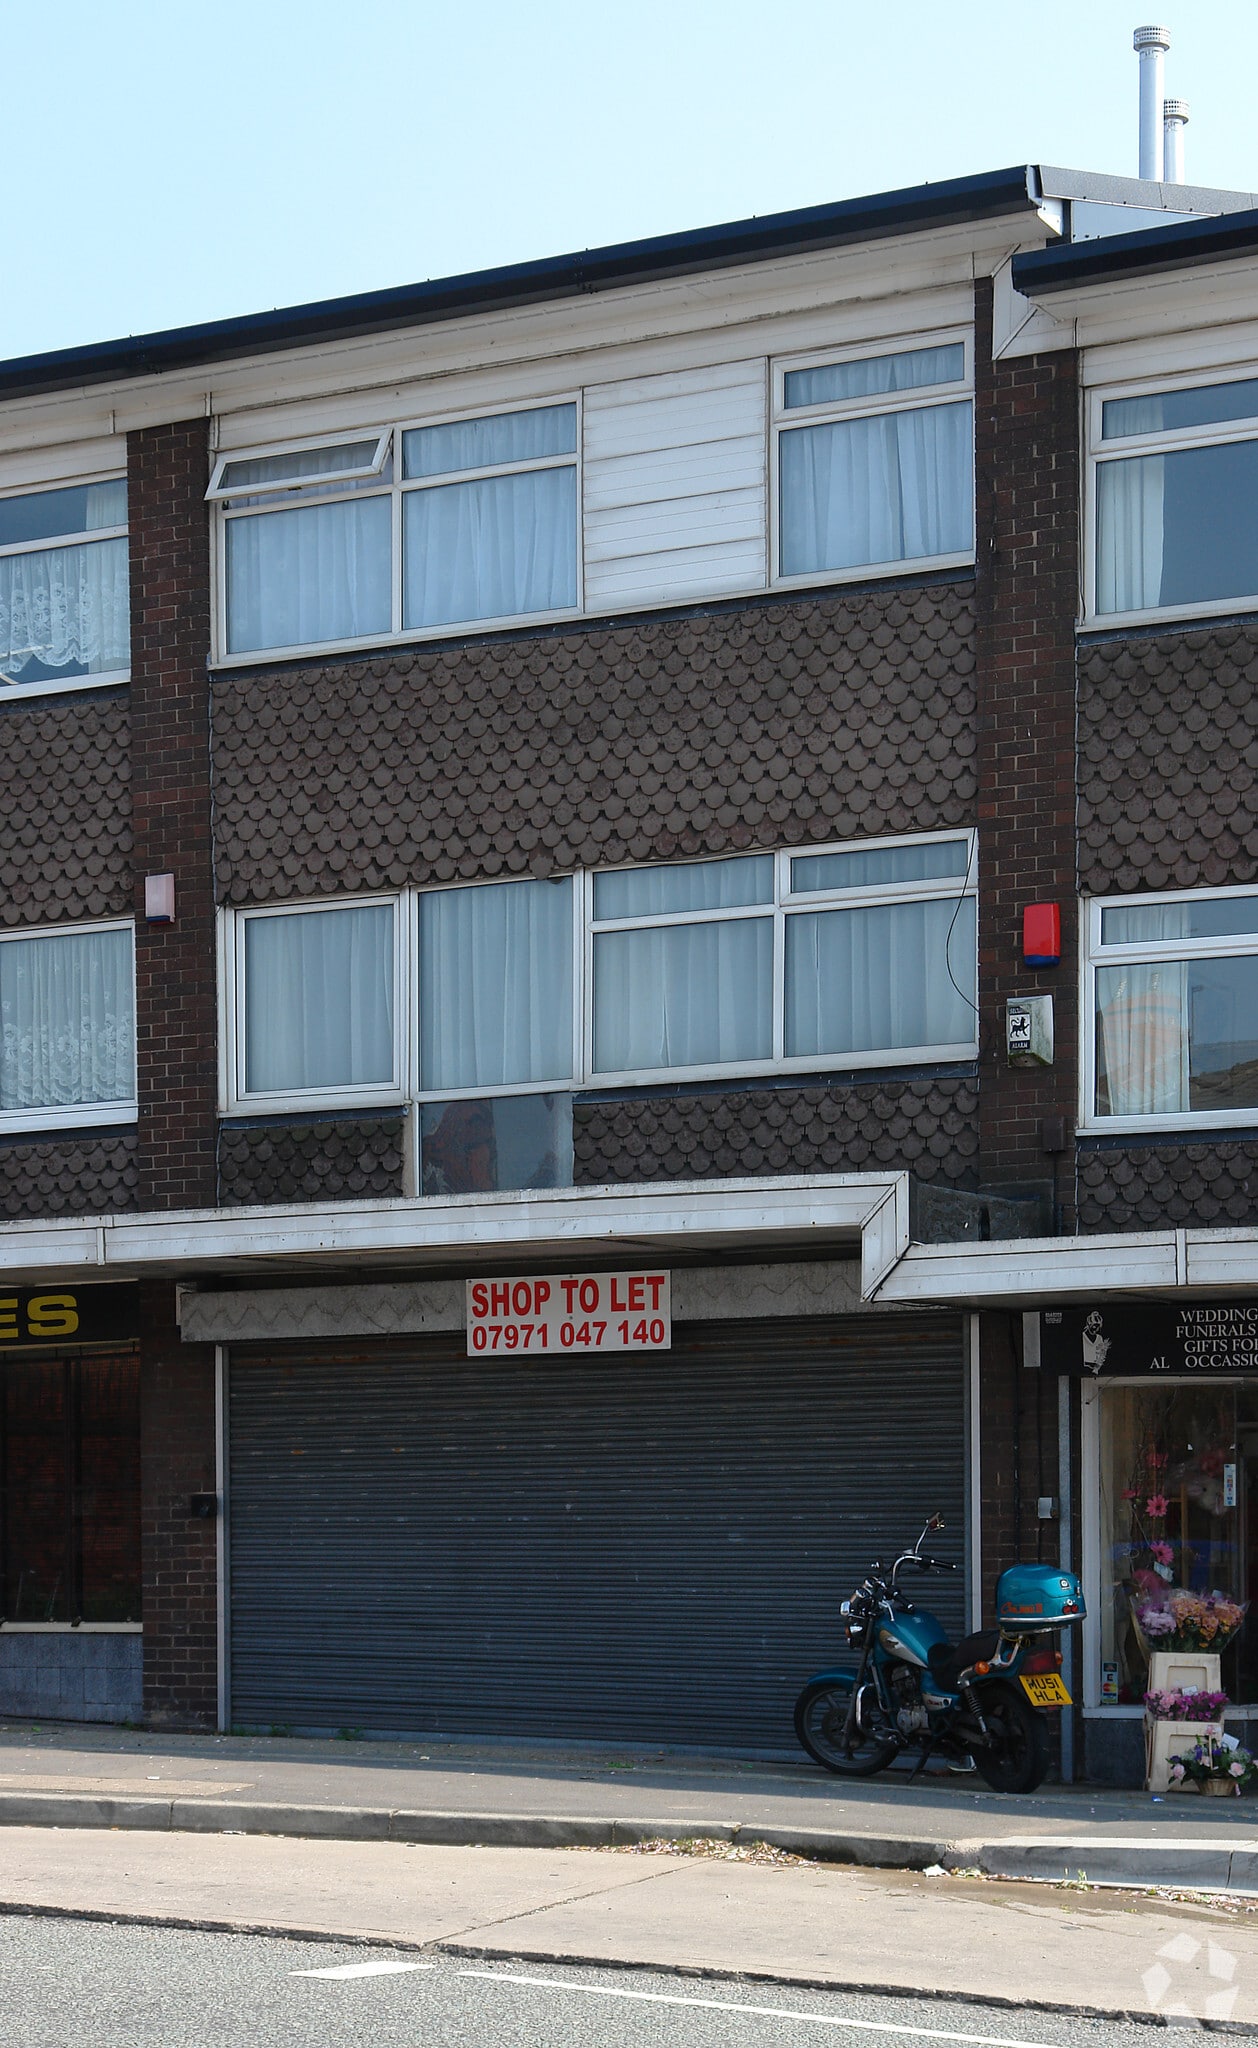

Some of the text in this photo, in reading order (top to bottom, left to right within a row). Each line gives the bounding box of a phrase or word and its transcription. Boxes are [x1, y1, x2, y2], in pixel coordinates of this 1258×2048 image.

[472, 1275, 665, 1317] SHOP TO LET
[1180, 1308, 1258, 1323] WEDDING
[472, 1318, 665, 1351] 07971 047 140
[1175, 1323, 1257, 1339] FUNERALS
[1184, 1338, 1258, 1353] GIFTS FO
[1149, 1356, 1170, 1369] AL
[1027, 1678, 1060, 1690] MU51
[1034, 1690, 1064, 1701] HLA
